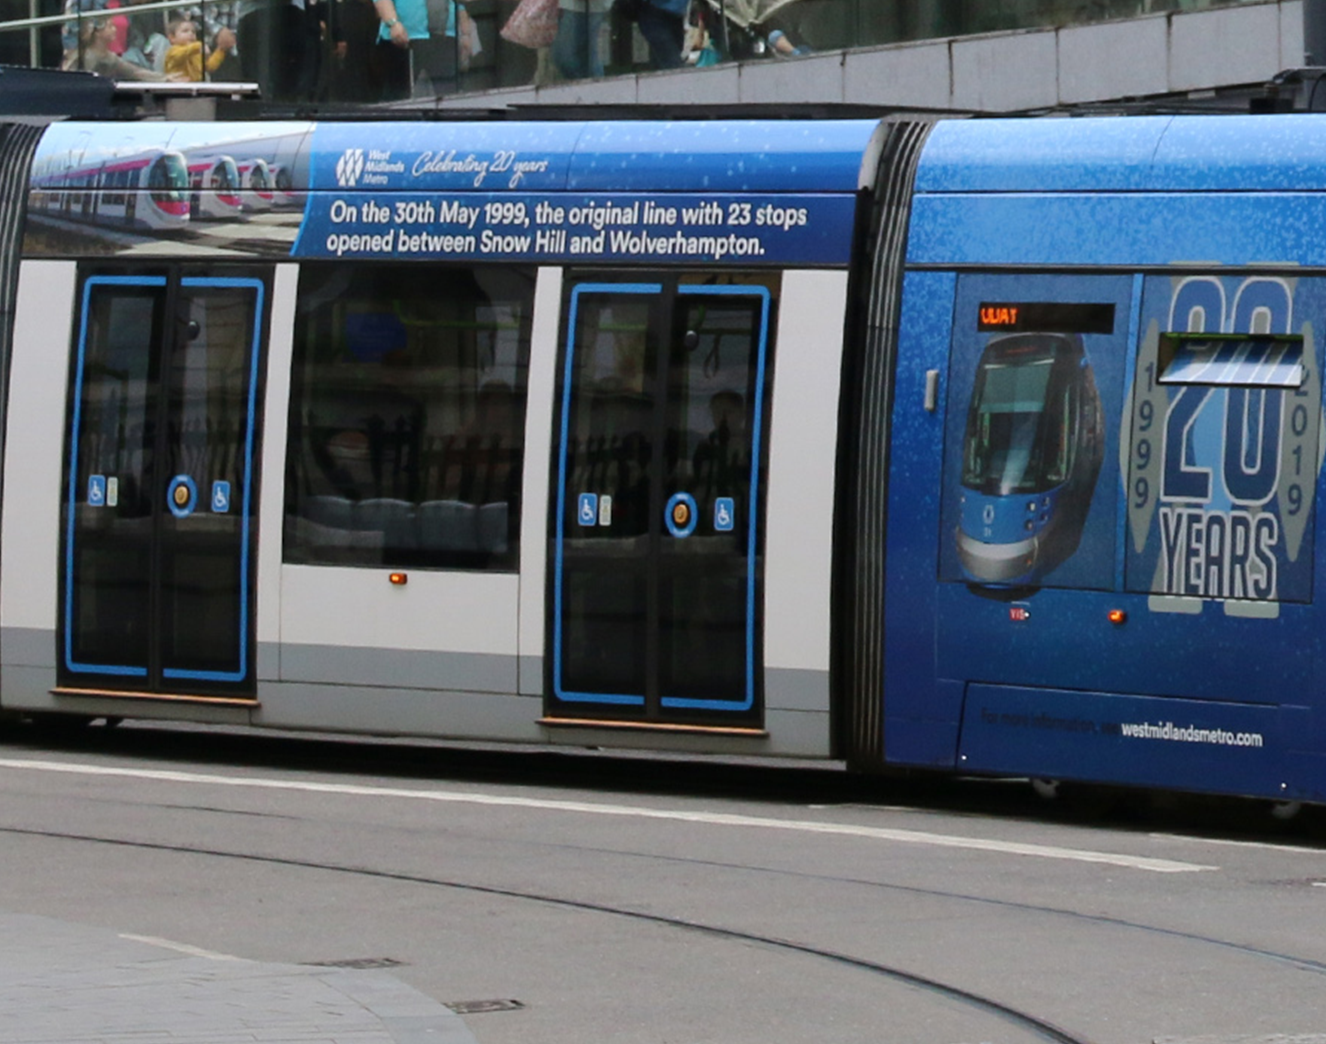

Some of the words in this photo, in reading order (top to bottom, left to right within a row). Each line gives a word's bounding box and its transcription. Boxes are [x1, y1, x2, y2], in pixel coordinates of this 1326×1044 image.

[364, 160, 405, 173] Midlands
[368, 149, 392, 160] West
[411, 149, 488, 188] Celebrating
[489, 149, 516, 173] 20
[507, 159, 548, 189] years
[362, 173, 389, 185] Metro
[330, 199, 358, 224] On
[362, 199, 390, 224] the
[394, 199, 435, 224] 30th
[439, 201, 480, 230] May
[484, 202, 530, 228] 1999,
[535, 201, 564, 226] the
[568, 201, 639, 231] original
[643, 201, 677, 226] line
[682, 201, 723, 226] with
[727, 202, 752, 226] 23
[755, 203, 808, 231] stops
[326, 229, 394, 257] opened
[398, 229, 476, 253] between
[480, 230, 531, 254] Snow
[535, 230, 566, 254] Hill
[570, 230, 605, 254] and
[610, 230, 765, 260] Wolverhampton.
[1160, 275, 1292, 506] 20
[1158, 506, 1279, 602] YEARS
[1121, 721, 1263, 748] westmidlandsmetro.com
